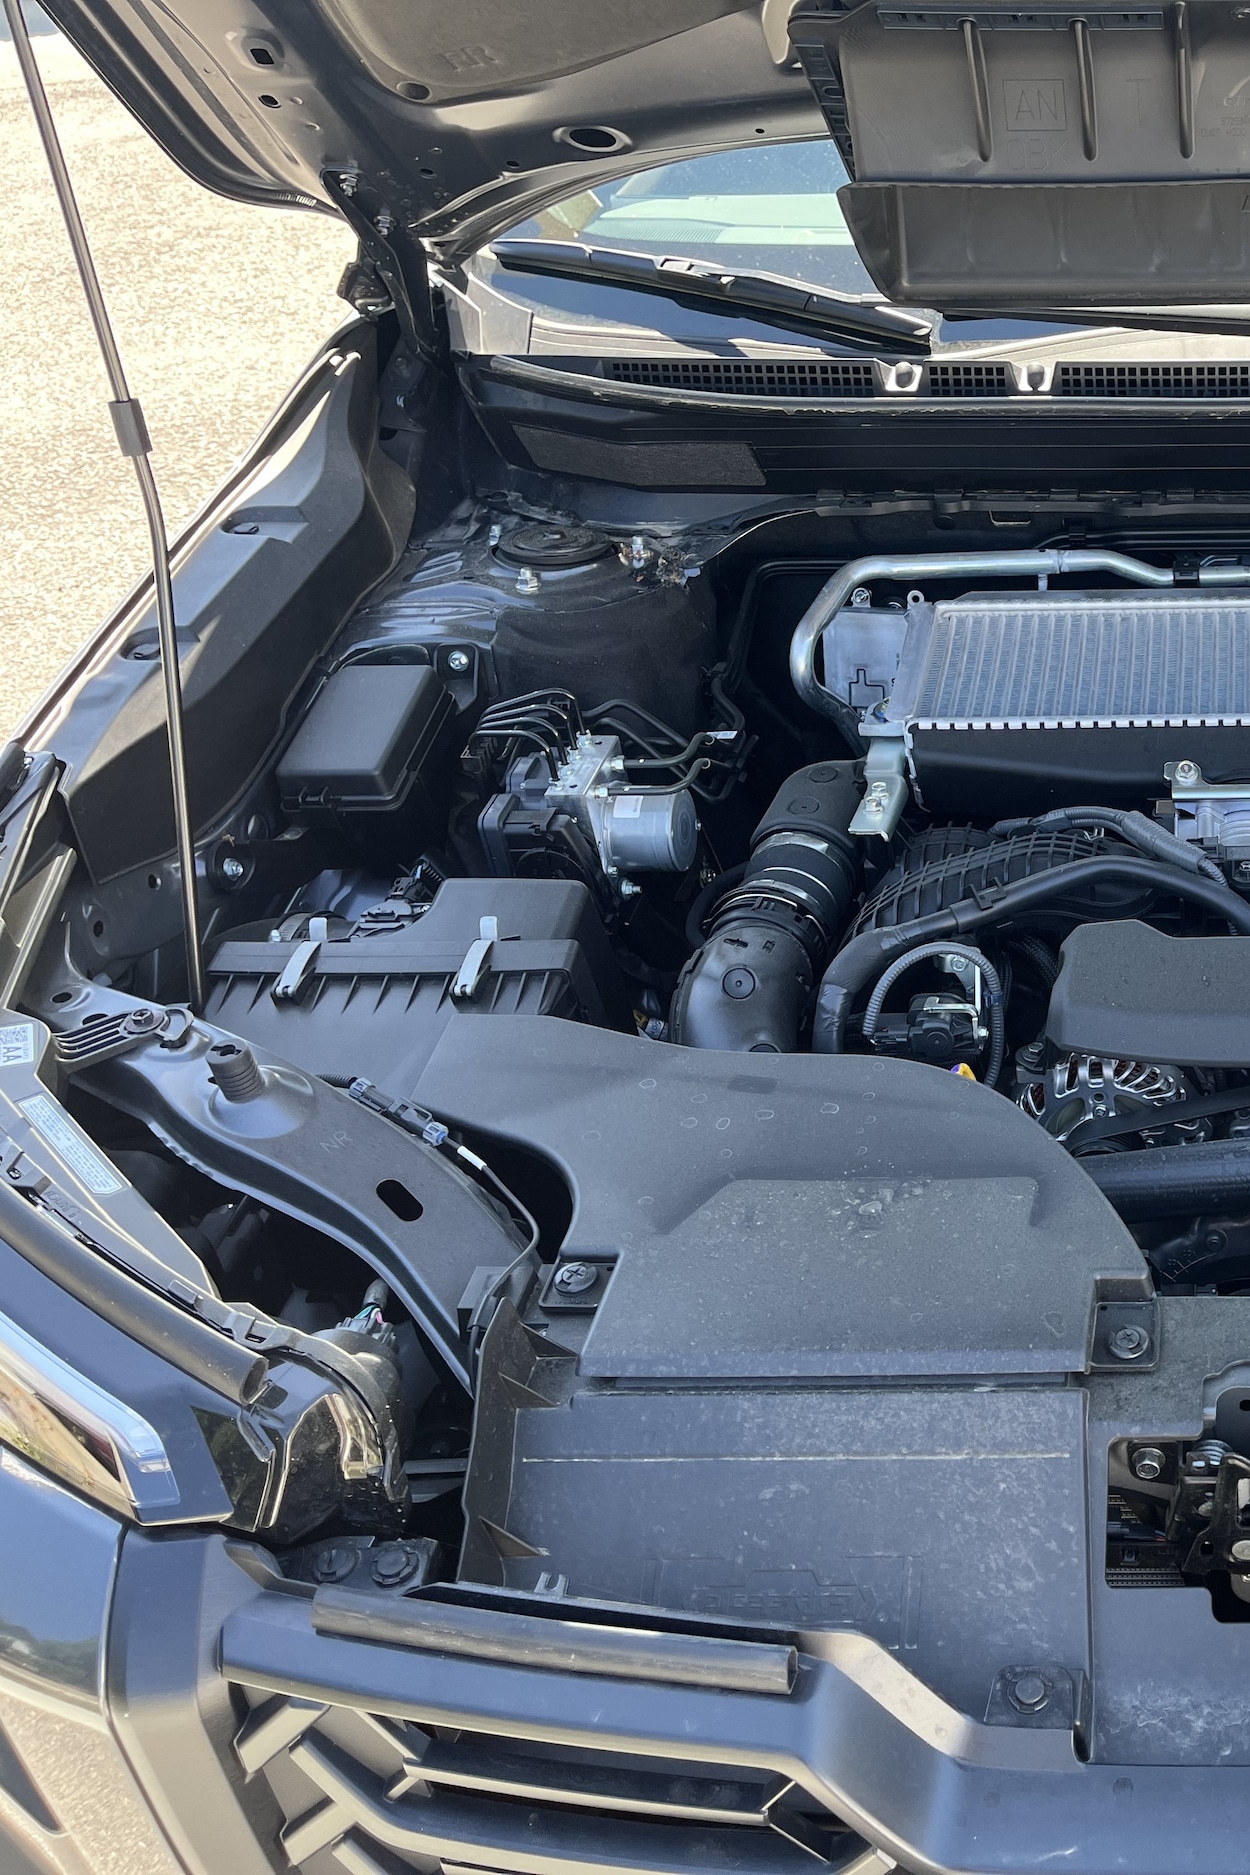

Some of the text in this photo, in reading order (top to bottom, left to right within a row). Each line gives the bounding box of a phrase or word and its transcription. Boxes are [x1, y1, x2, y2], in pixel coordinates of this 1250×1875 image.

[1015, 90, 1058, 121] AN
[2, 1046, 22, 1062] AA
[320, 1130, 352, 1153] NR
